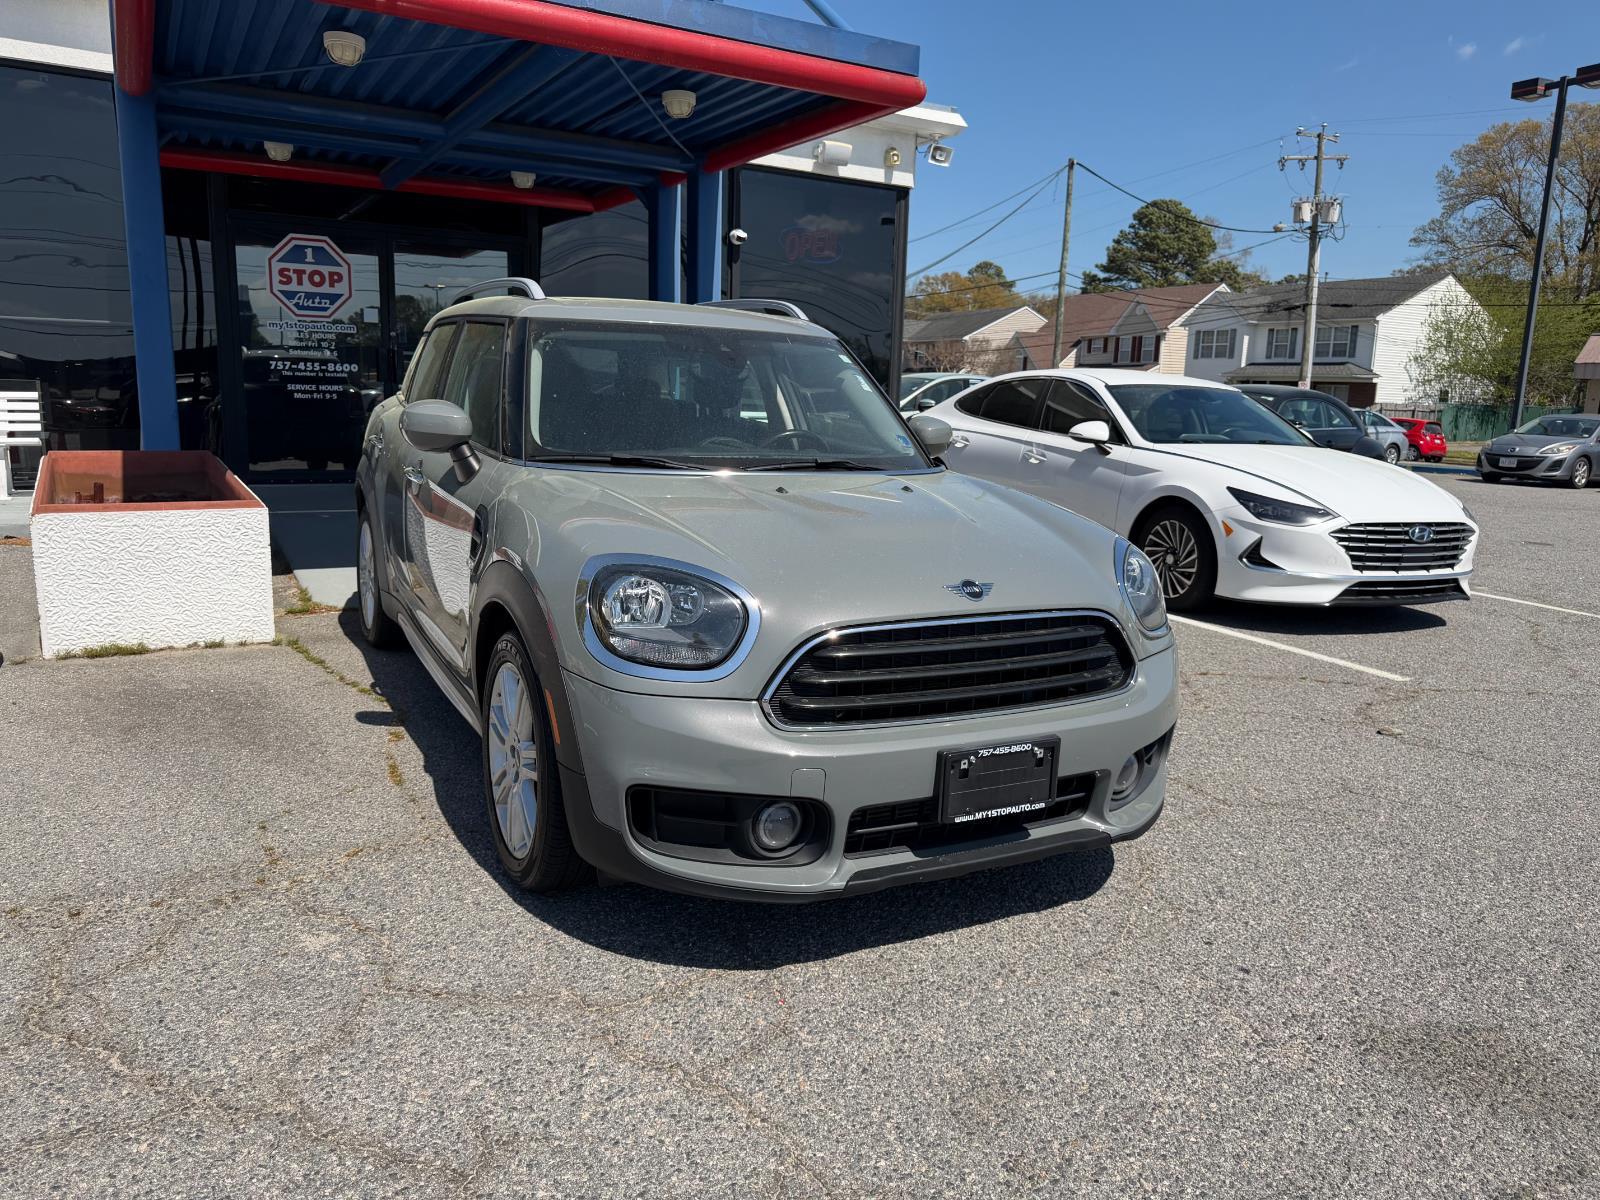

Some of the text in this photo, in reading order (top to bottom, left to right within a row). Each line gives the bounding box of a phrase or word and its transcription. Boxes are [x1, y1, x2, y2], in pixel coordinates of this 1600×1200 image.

[304, 247, 315, 262] 1
[277, 267, 344, 288] STOP
[289, 292, 333, 308] Auto
[267, 320, 356, 333] my1stopauto.com
[289, 349, 321, 357] Saturday
[269, 361, 359, 372] 757-455-8600
[319, 384, 343, 392] HOURS
[962, 585, 982, 593] MINI
[977, 743, 1032, 758] 757-455-8600
[954, 802, 1046, 823] www.MY1STOPAUTO.com
